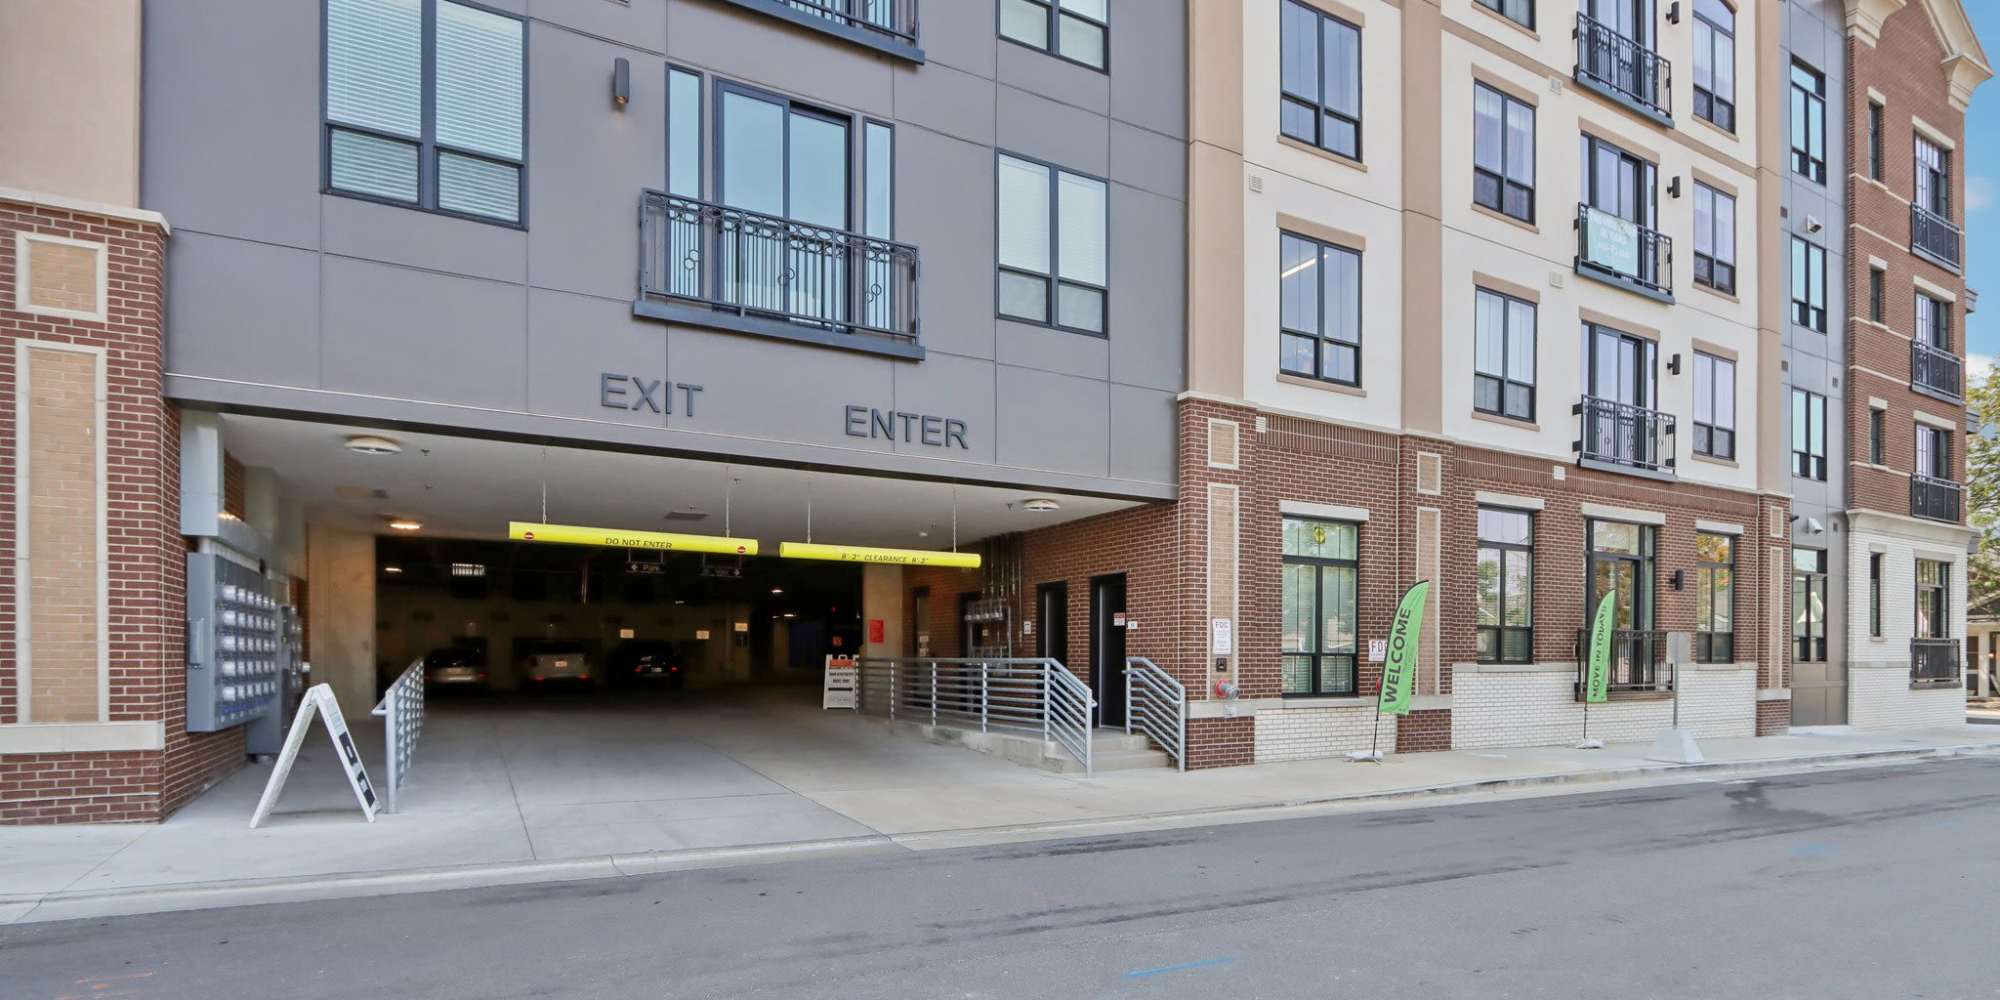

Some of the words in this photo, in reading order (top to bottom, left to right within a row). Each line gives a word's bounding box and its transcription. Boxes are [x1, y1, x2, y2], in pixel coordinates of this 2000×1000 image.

[600, 373, 703, 417] EXIT
[845, 404, 969, 450] ENTER
[605, 537, 619, 545] DO
[622, 538, 641, 547] NOT
[643, 540, 672, 549] ENTER
[864, 553, 908, 563] CLEARANCE
[1384, 607, 1411, 703] WELCOME
[1595, 650, 1601, 662] IN
[1592, 665, 1600, 697] MOVE
